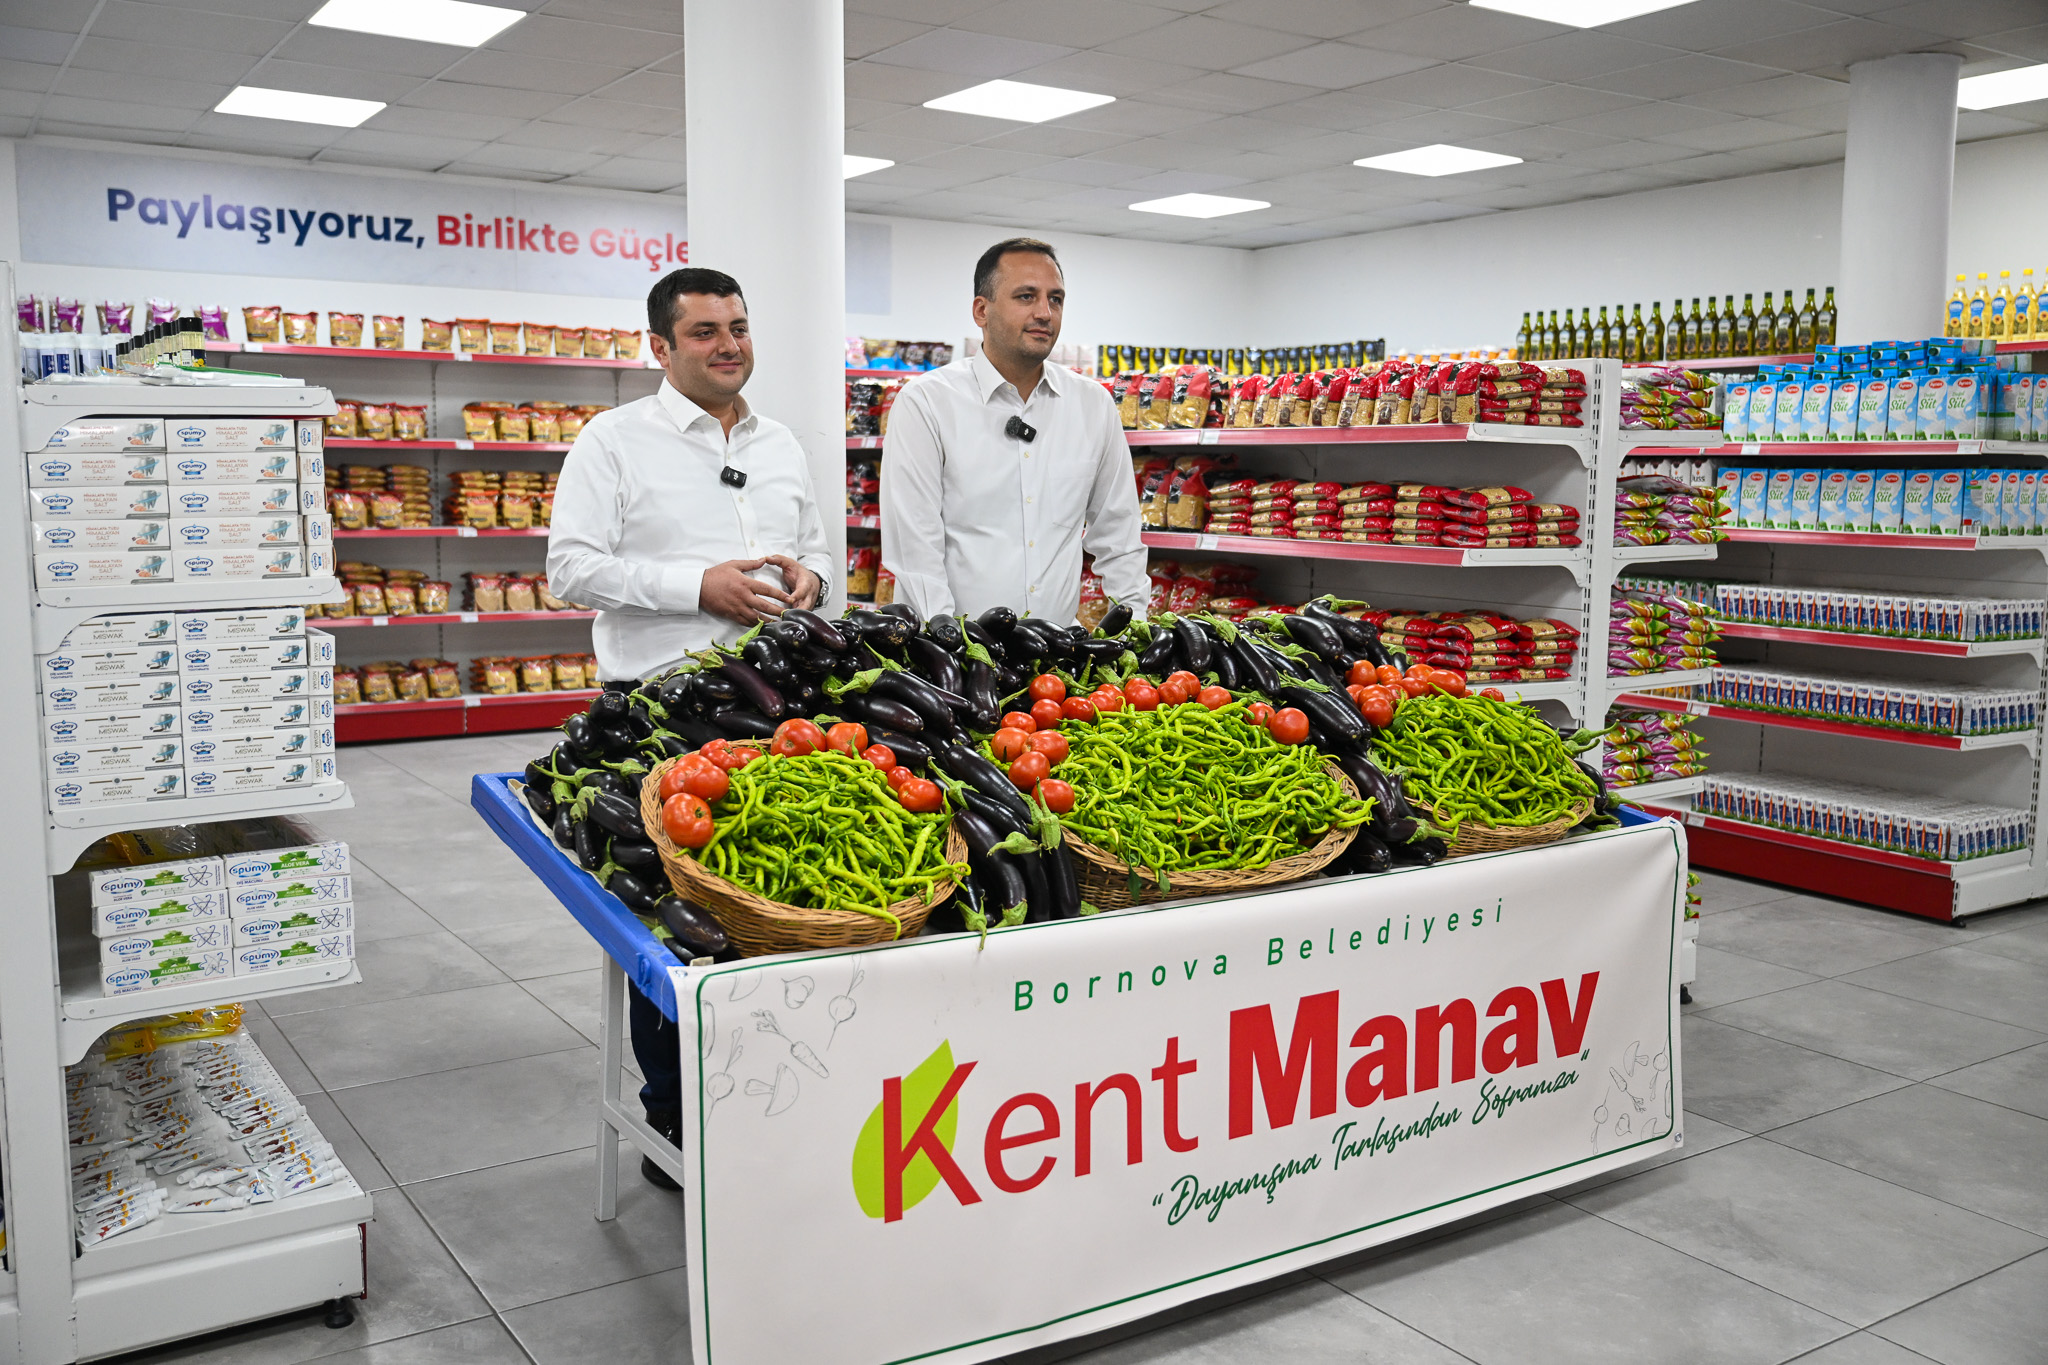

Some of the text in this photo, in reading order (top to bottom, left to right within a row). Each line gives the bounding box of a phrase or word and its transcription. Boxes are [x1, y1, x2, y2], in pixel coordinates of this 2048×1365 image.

[106, 187, 425, 249] Paylaşıyoruz,
[437, 213, 579, 255] Birlikte
[1751, 402, 1766, 414] Süt
[1778, 401, 1793, 413] Süt
[1804, 401, 1820, 413] Süt
[1832, 399, 1849, 412] Süt
[1860, 398, 1878, 412] Süt
[1890, 397, 1907, 411] Süt
[1919, 396, 1937, 410] Süt
[1947, 394, 1966, 410] Süt
[1726, 403, 1740, 414] Süt
[1742, 488, 1757, 500] Süt
[1768, 488, 1784, 500] Süt
[1794, 489, 1810, 501] Süt
[1822, 490, 1838, 502] Süt
[1848, 491, 1864, 502] Süt
[1875, 491, 1892, 503] Süt
[1905, 492, 1922, 504] Süt
[1934, 491, 1952, 504] Süt
[233, 863, 267, 875] spumy
[104, 880, 140, 892] spumy
[240, 892, 273, 903] spumy
[109, 910, 145, 922] spumy
[243, 923, 276, 933] spumy
[113, 941, 148, 953] spumy
[243, 952, 276, 962] spumy
[1014, 897, 1502, 1011] Bornova Belediyesi
[160, 967, 175, 975] ALOE
[108, 971, 146, 984] spumy
[884, 970, 1601, 1224] Kent Manav
